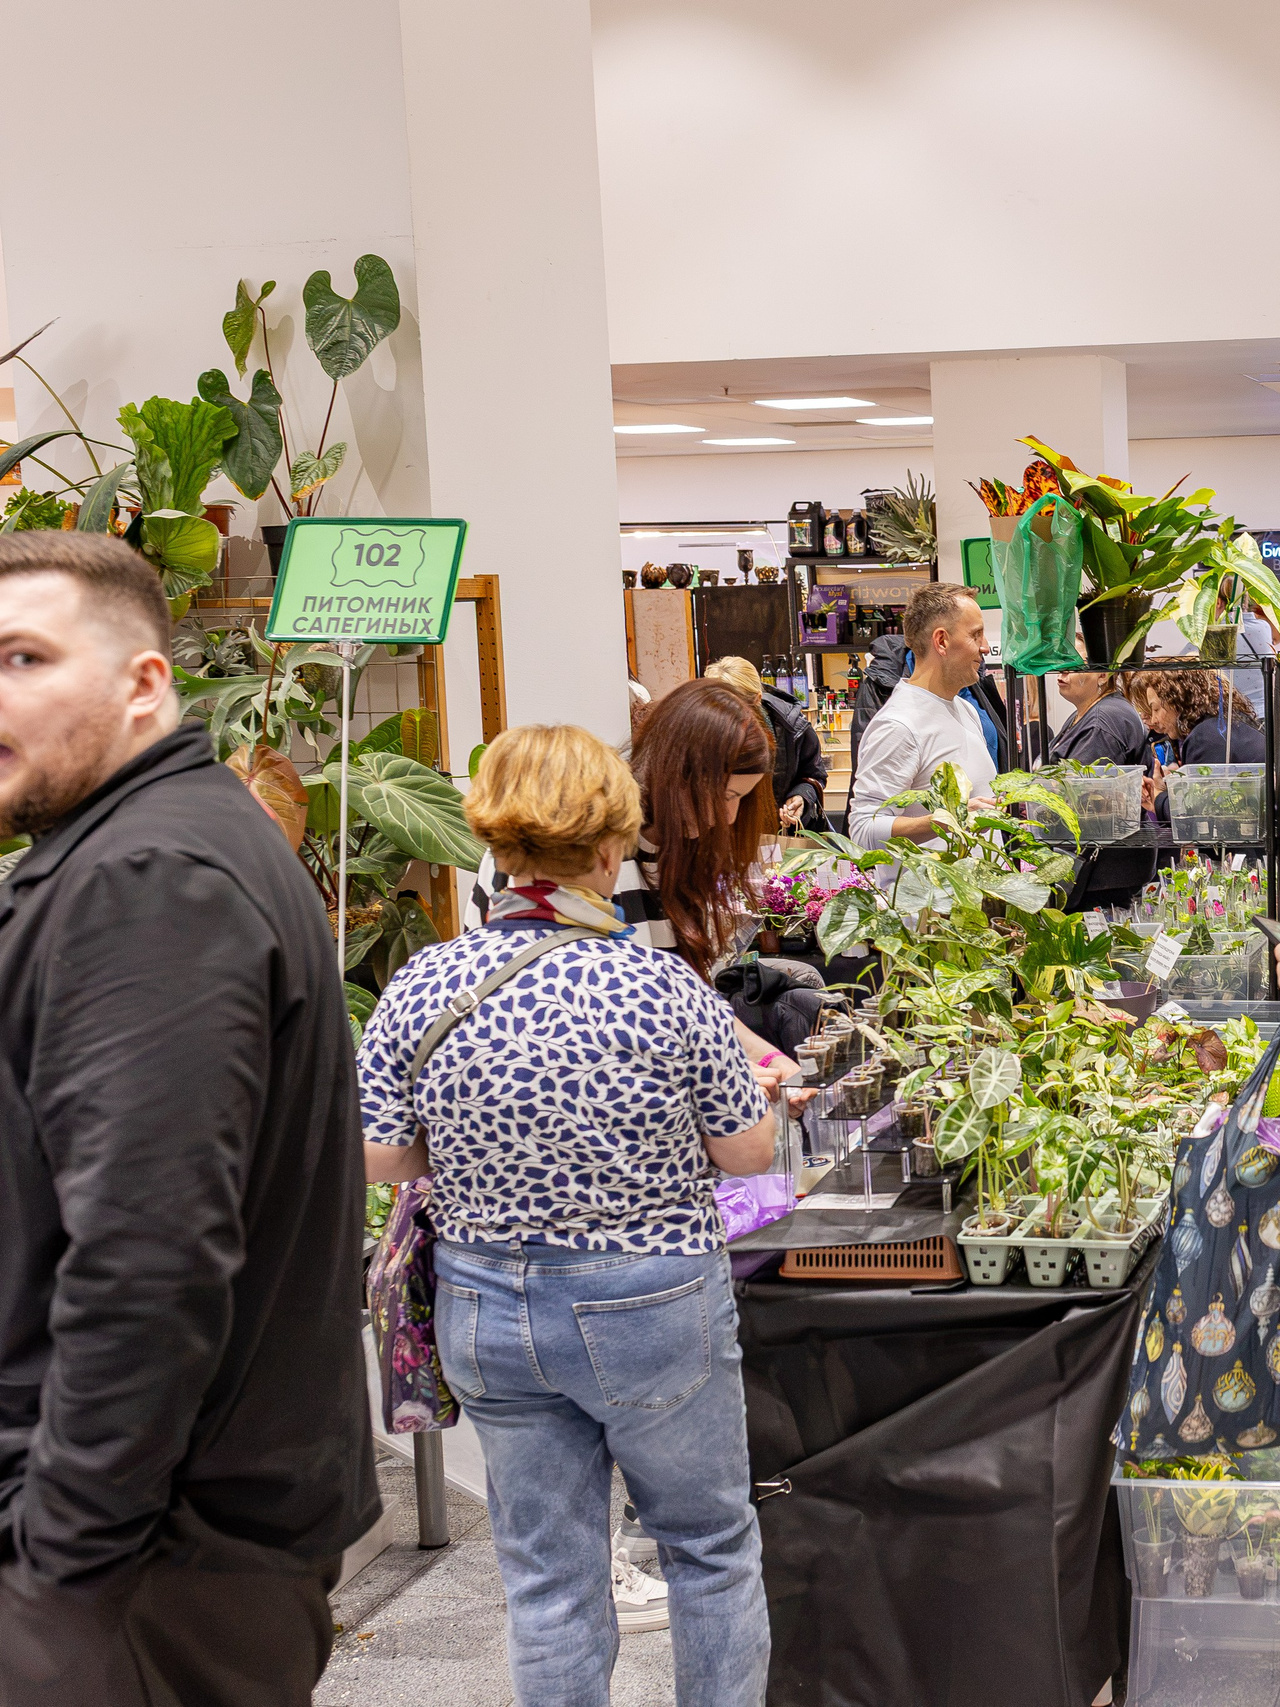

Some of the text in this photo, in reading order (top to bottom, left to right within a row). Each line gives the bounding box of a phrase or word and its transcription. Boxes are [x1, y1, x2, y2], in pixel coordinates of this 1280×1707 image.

[353, 543, 402, 567] 102
[302, 596, 433, 614] ПИТОМНИК
[292, 616, 434, 635] САПЕГИНЫХ
